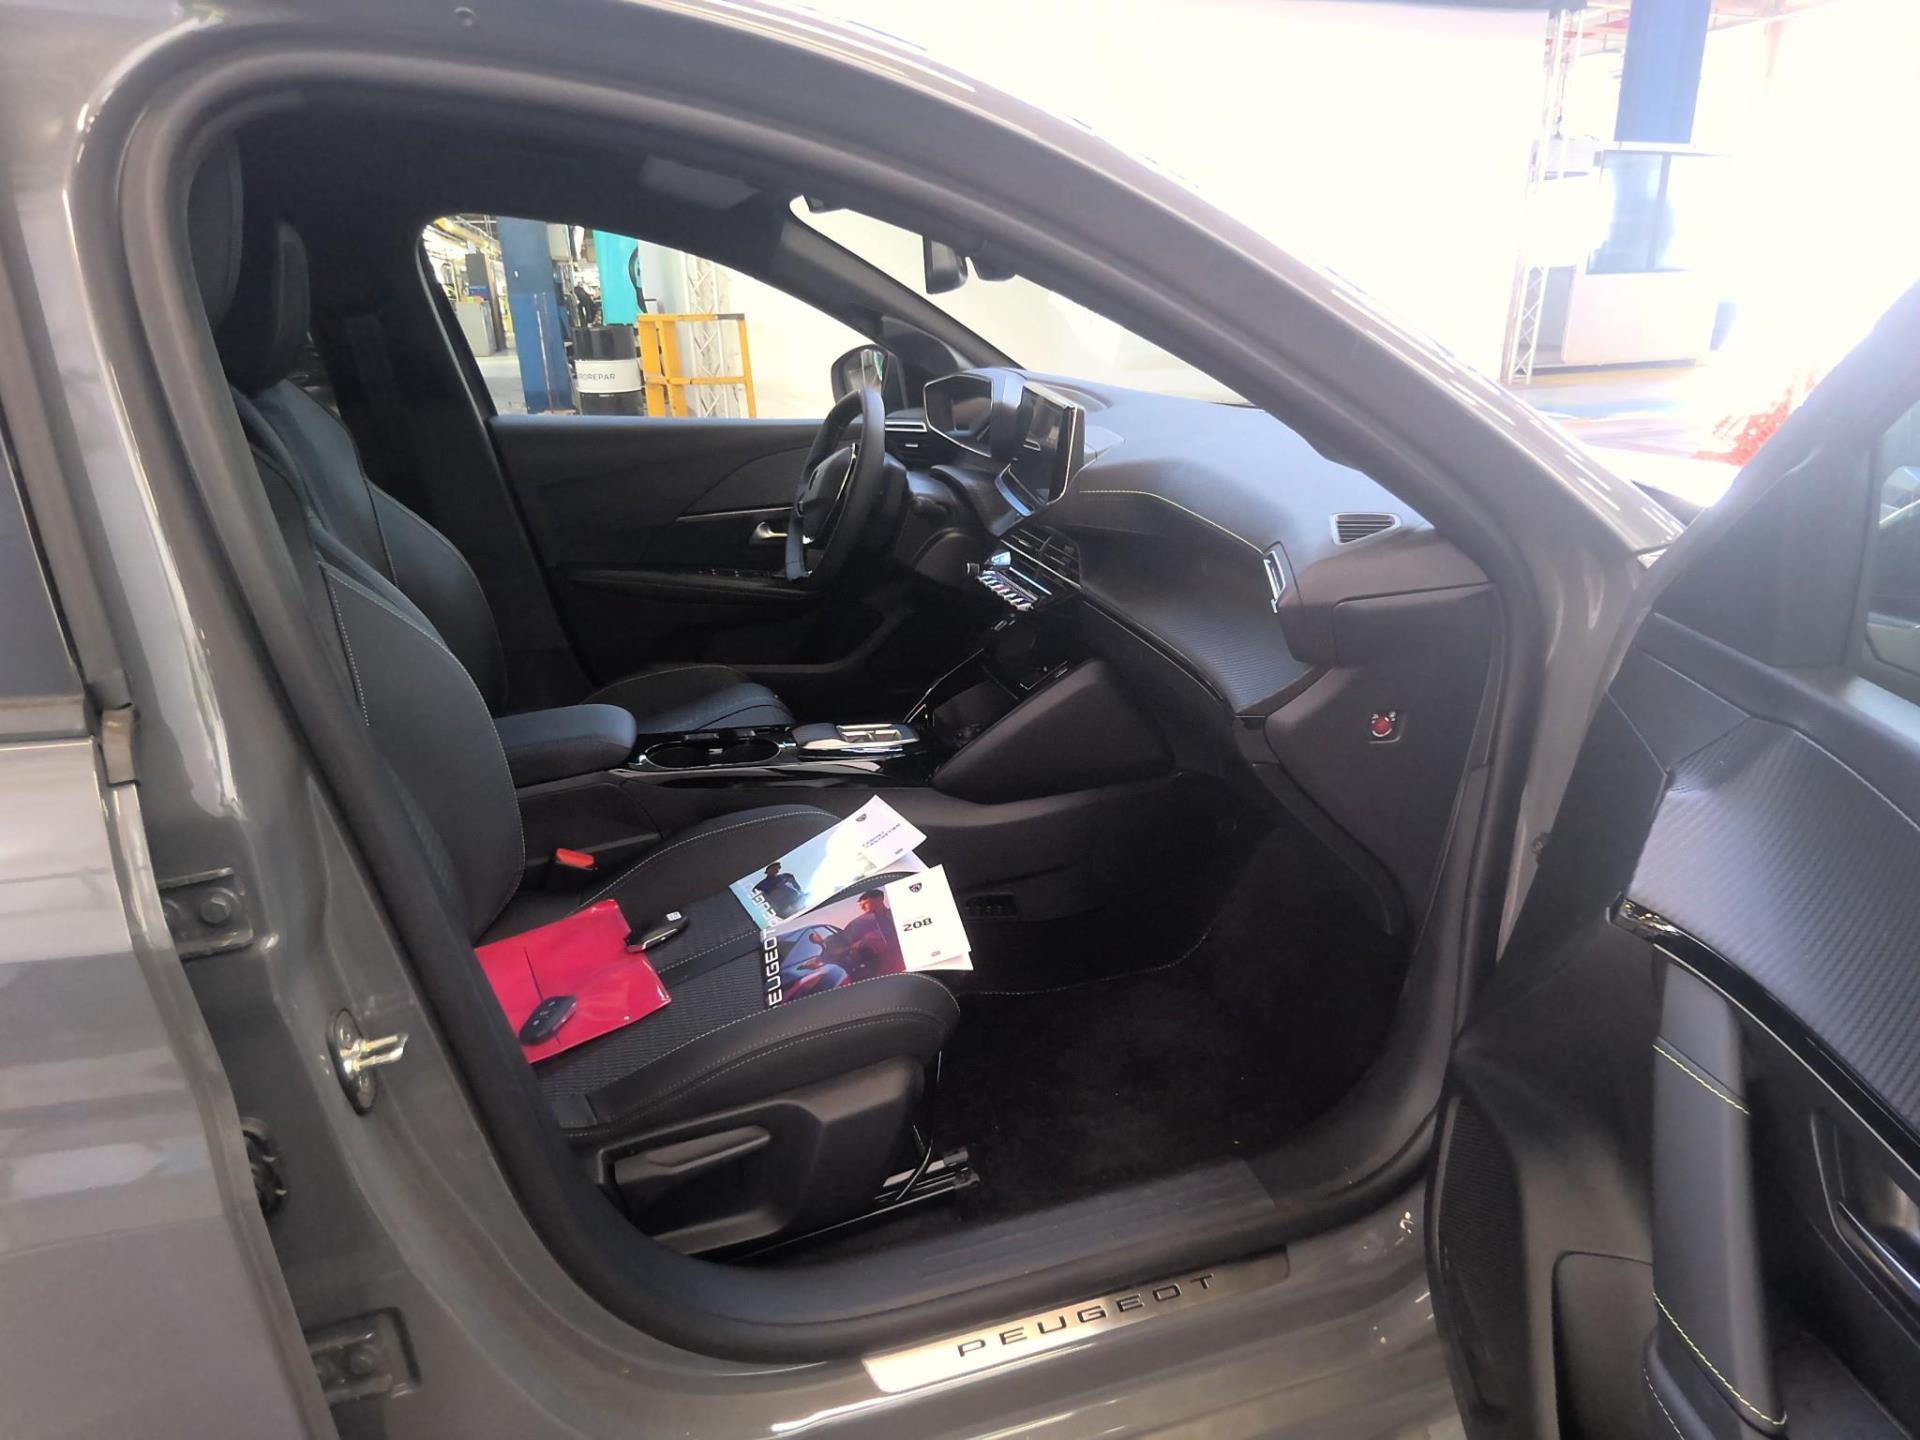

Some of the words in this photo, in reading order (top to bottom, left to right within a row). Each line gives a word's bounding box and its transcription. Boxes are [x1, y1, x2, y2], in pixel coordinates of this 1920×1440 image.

[902, 917, 933, 932] 208
[763, 928, 783, 1006] EUGEOT
[957, 1273, 1214, 1357] PEUGEOT
